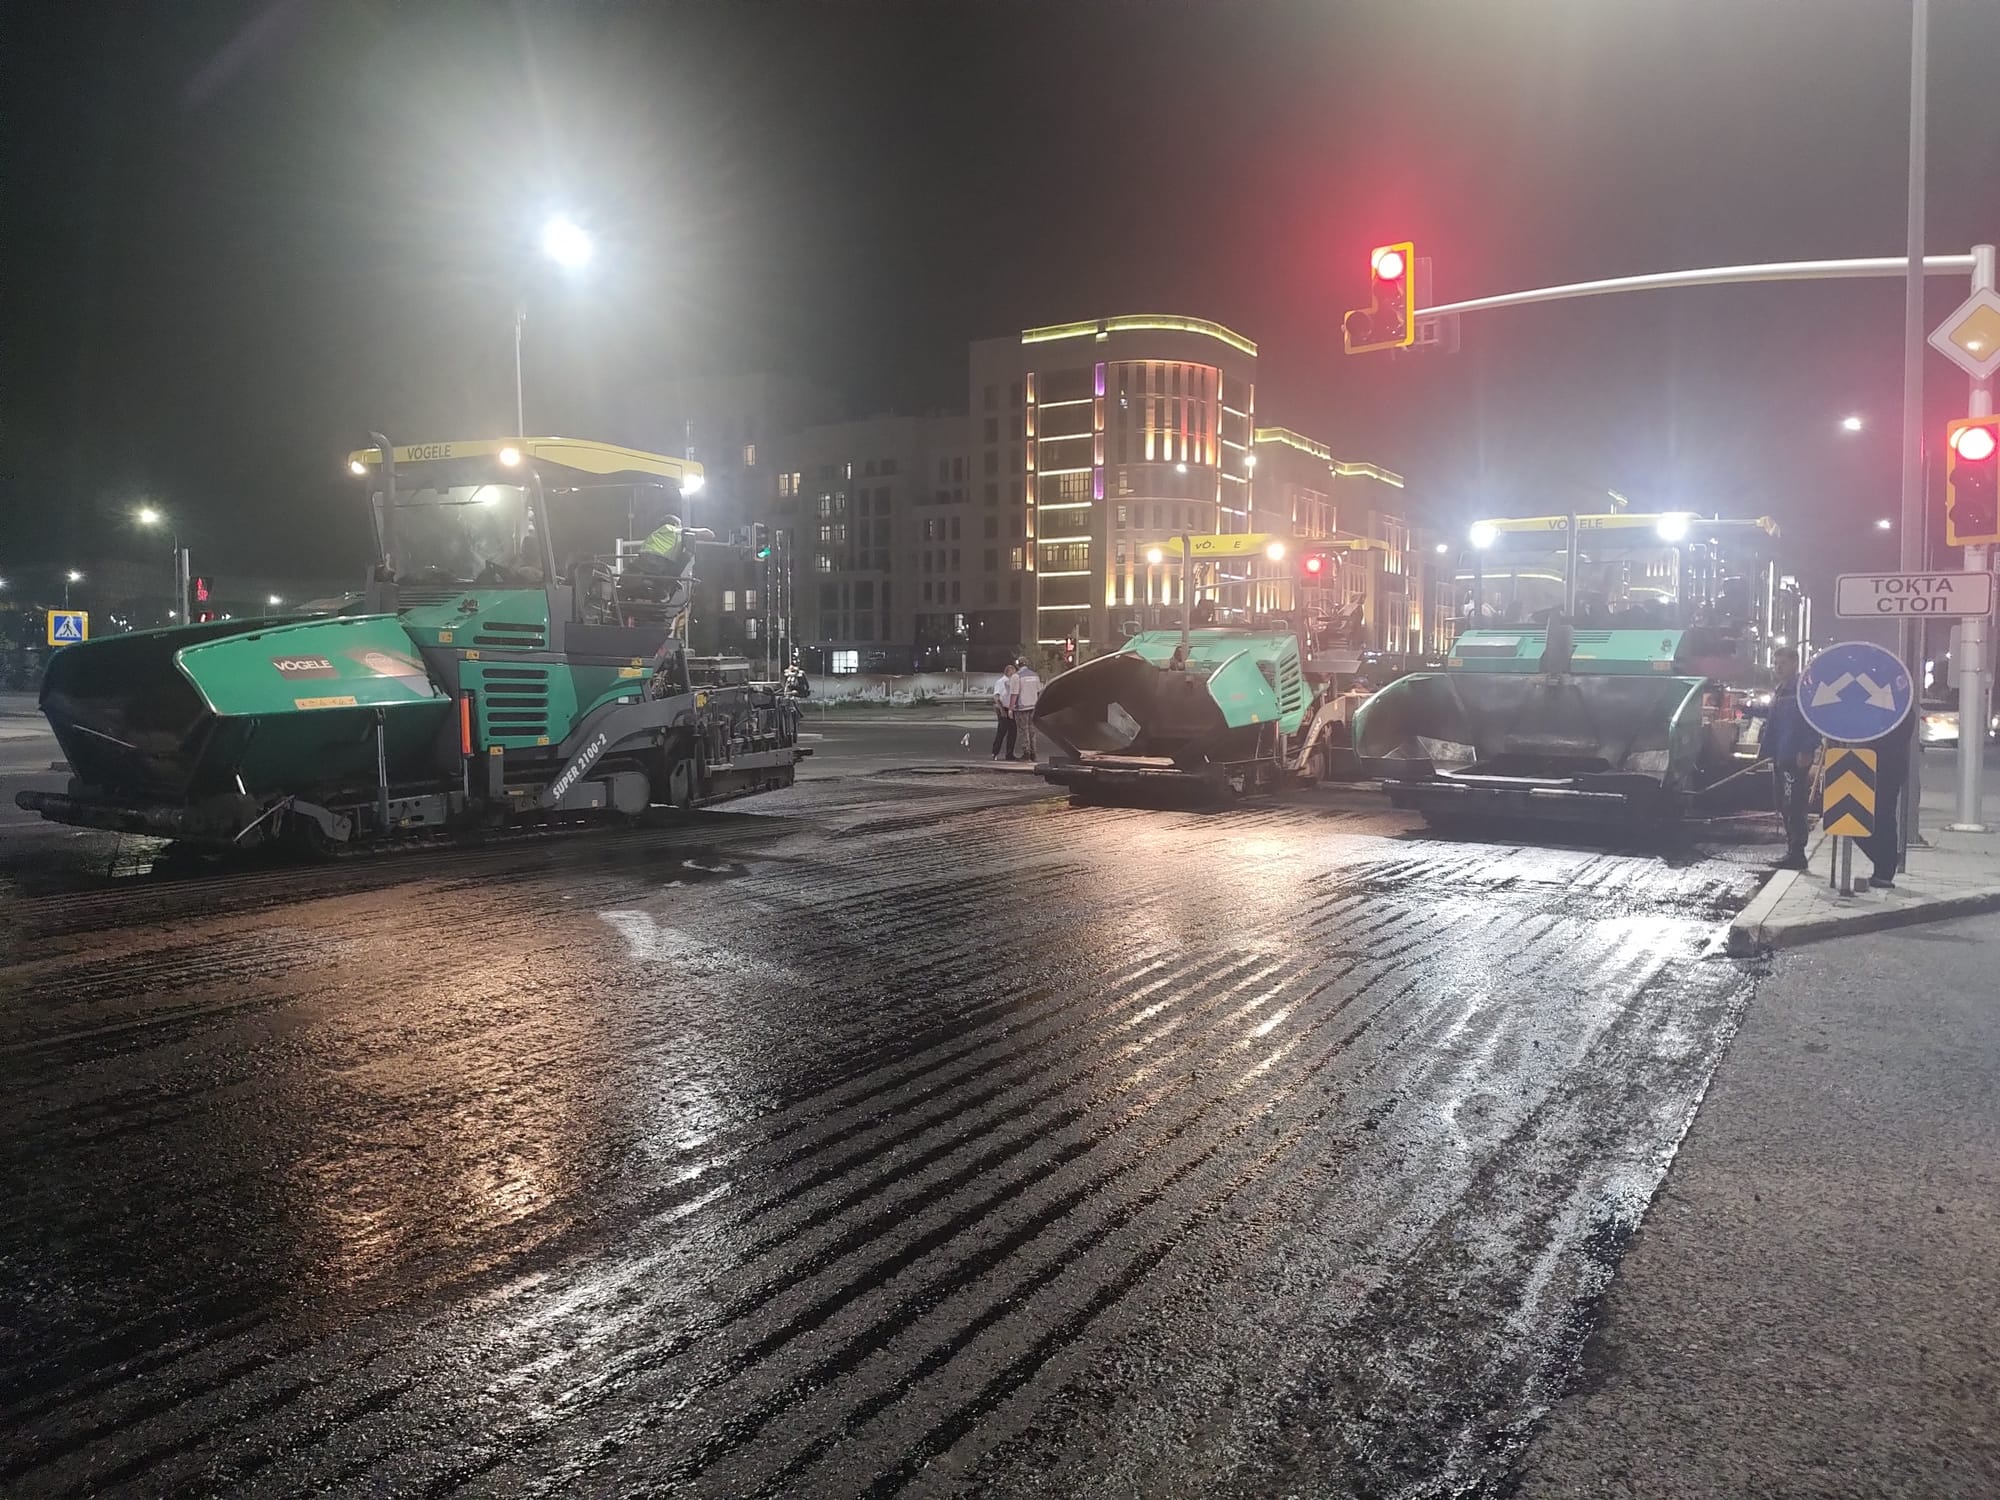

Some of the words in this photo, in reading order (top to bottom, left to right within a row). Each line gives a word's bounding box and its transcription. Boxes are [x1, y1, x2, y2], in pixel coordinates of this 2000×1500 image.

[1548, 517, 1603, 530] VÖELE
[1870, 578, 1954, 596] ТОҚТА
[1876, 597, 1948, 613] СТОП
[552, 765, 580, 800] SUPER
[578, 732, 607, 770] 2100-2
